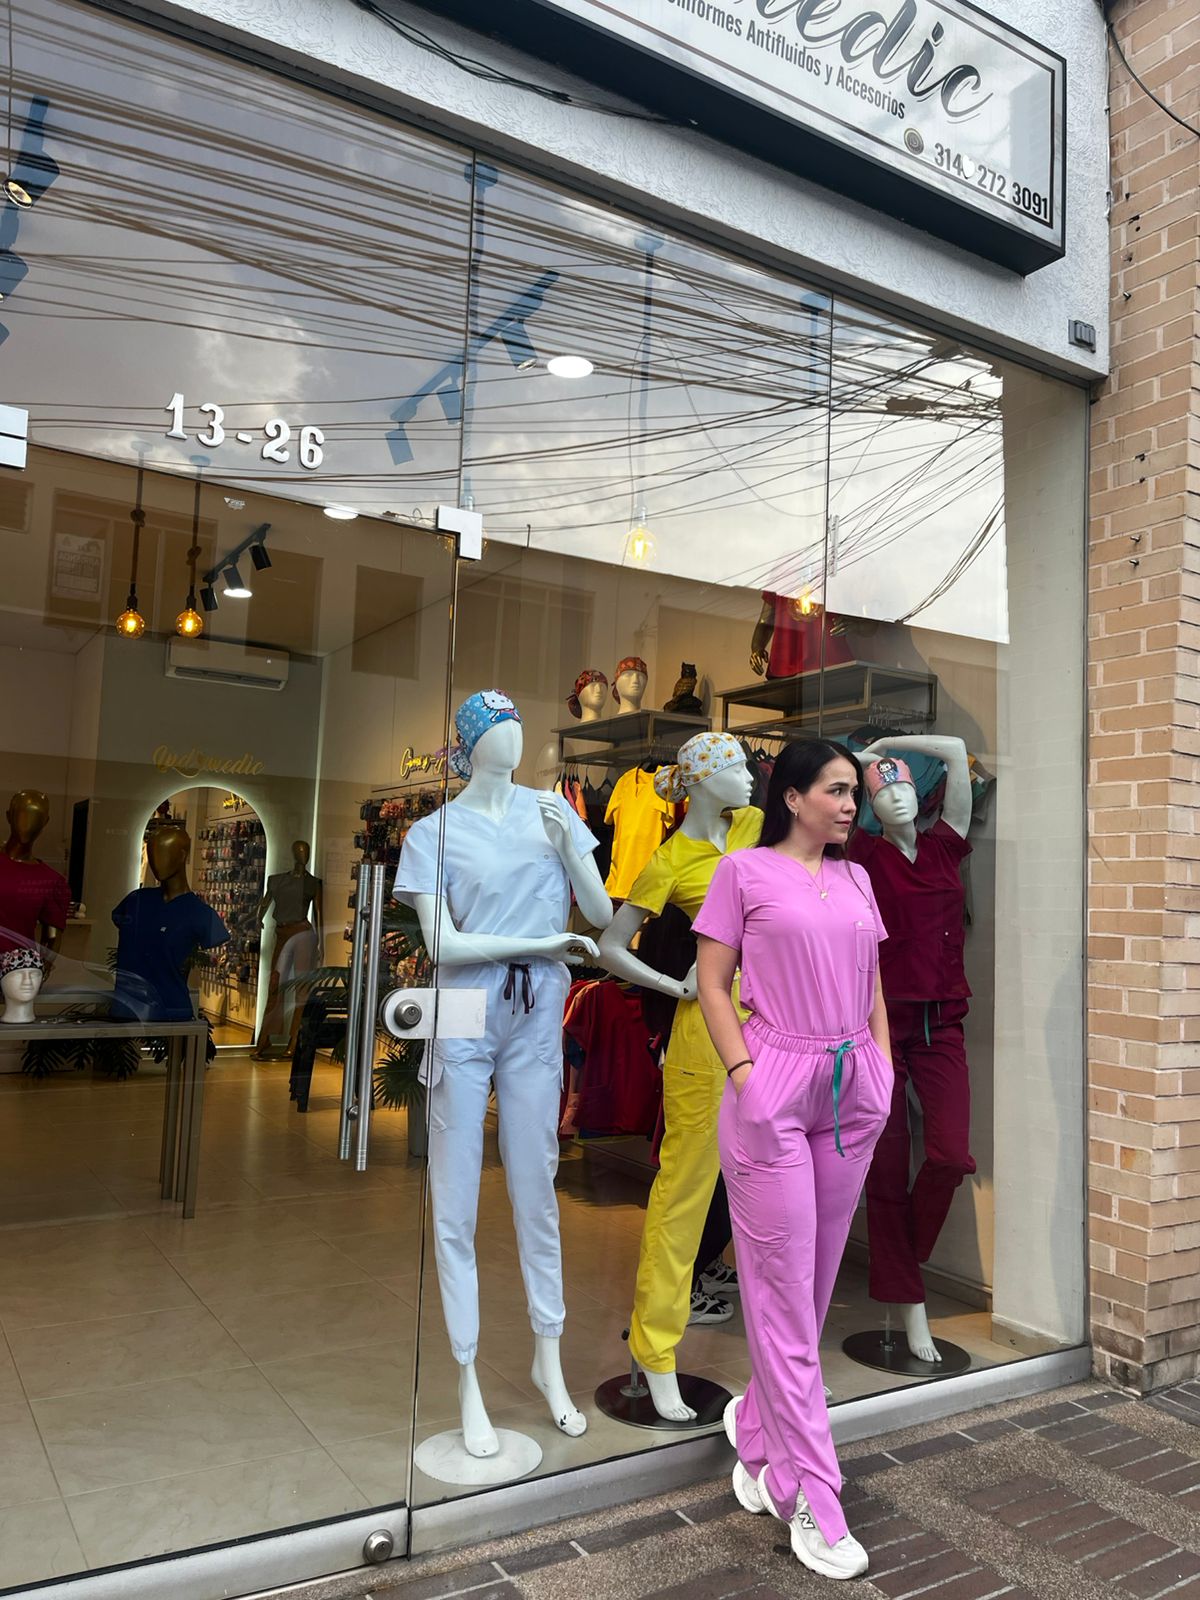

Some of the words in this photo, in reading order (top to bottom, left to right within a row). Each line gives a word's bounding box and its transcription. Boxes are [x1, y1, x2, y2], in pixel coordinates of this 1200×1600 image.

[668, 0, 742, 36] iformes
[746, 20, 821, 76] Antifluidos
[824, 63, 833, 85] y
[836, 66, 905, 119] Accesorios
[934, 143, 963, 176] 314
[977, 165, 1006, 198] 272
[1012, 182, 1048, 219] 3091
[166, 392, 325, 470] 13-26
